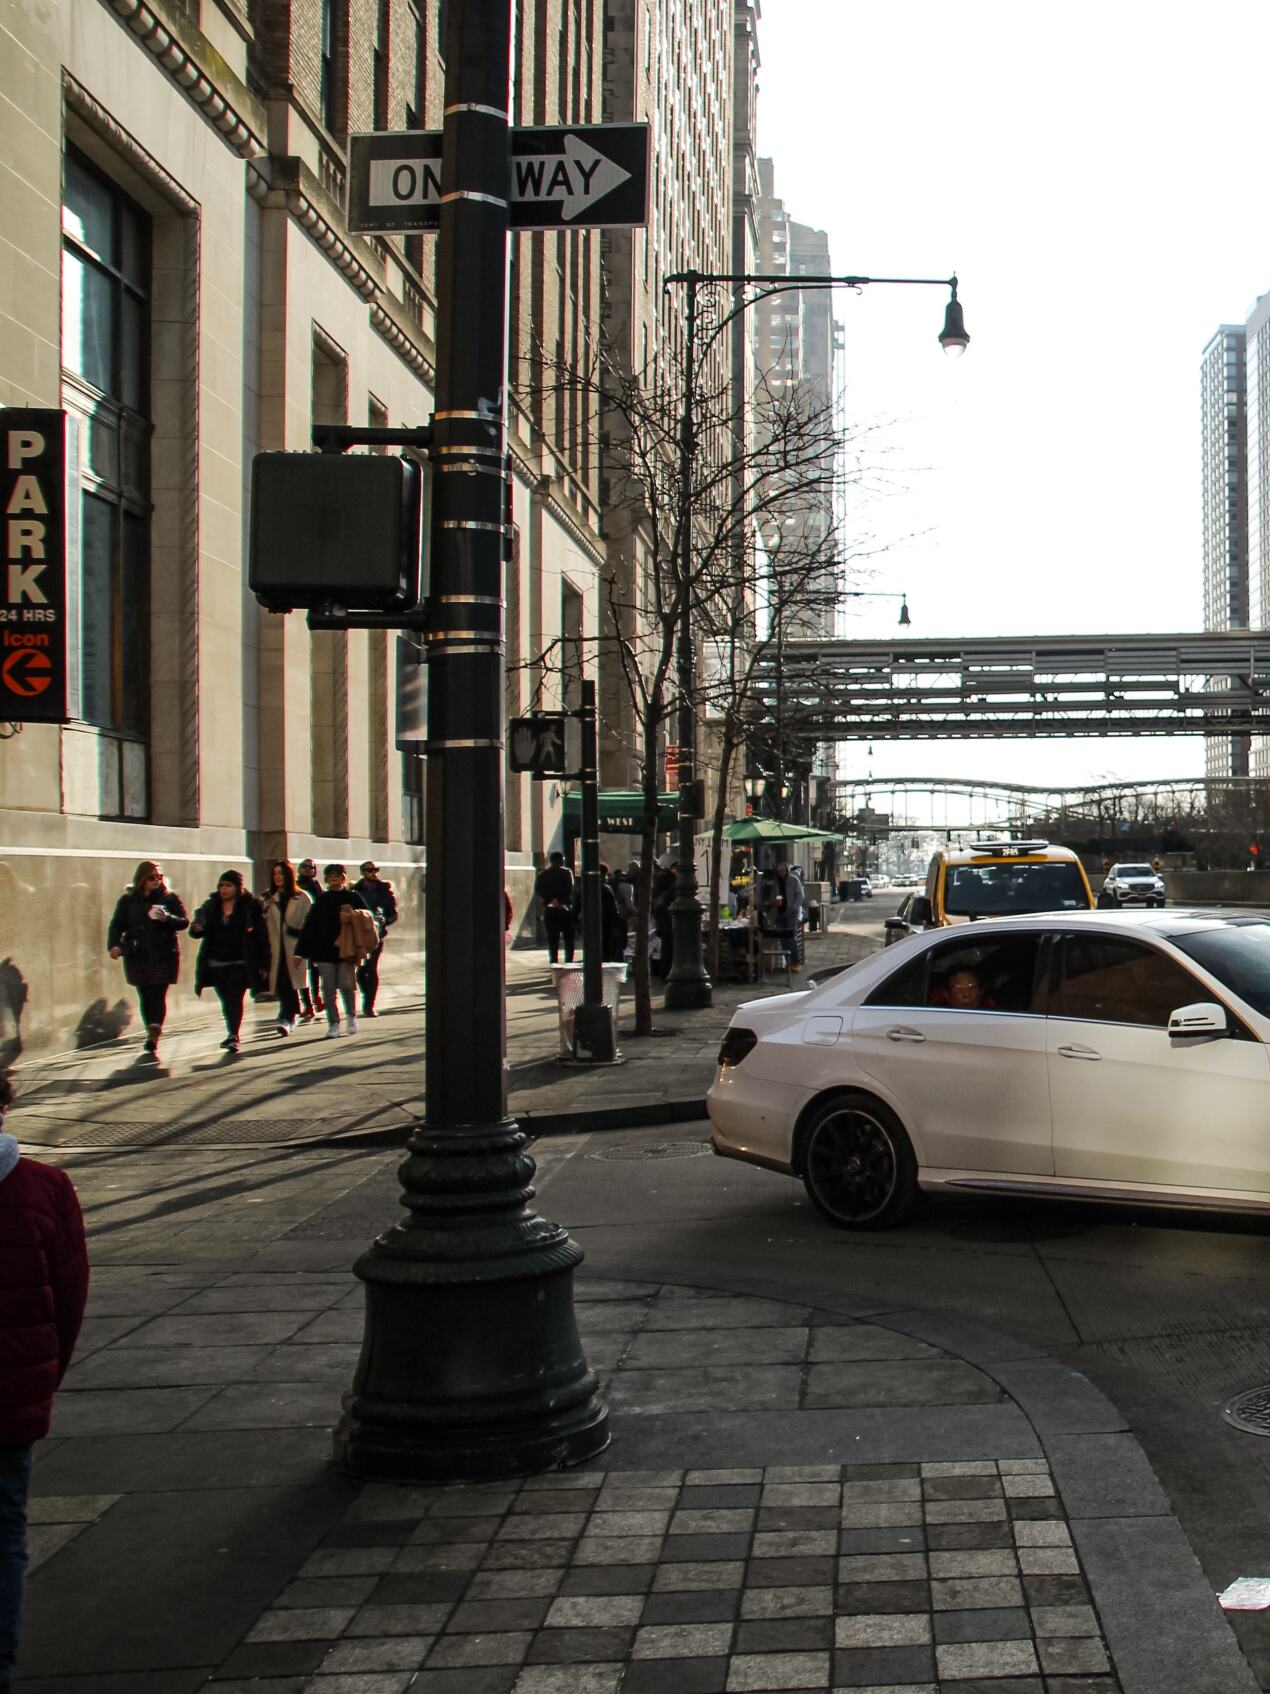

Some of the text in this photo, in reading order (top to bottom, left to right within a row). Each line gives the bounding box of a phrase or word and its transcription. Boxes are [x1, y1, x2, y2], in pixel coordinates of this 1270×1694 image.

[392, 159, 602, 200] ON WAY
[6, 430, 48, 603] PARK
[0, 609, 56, 622] 24 HRS
[3, 630, 49, 647] icon
